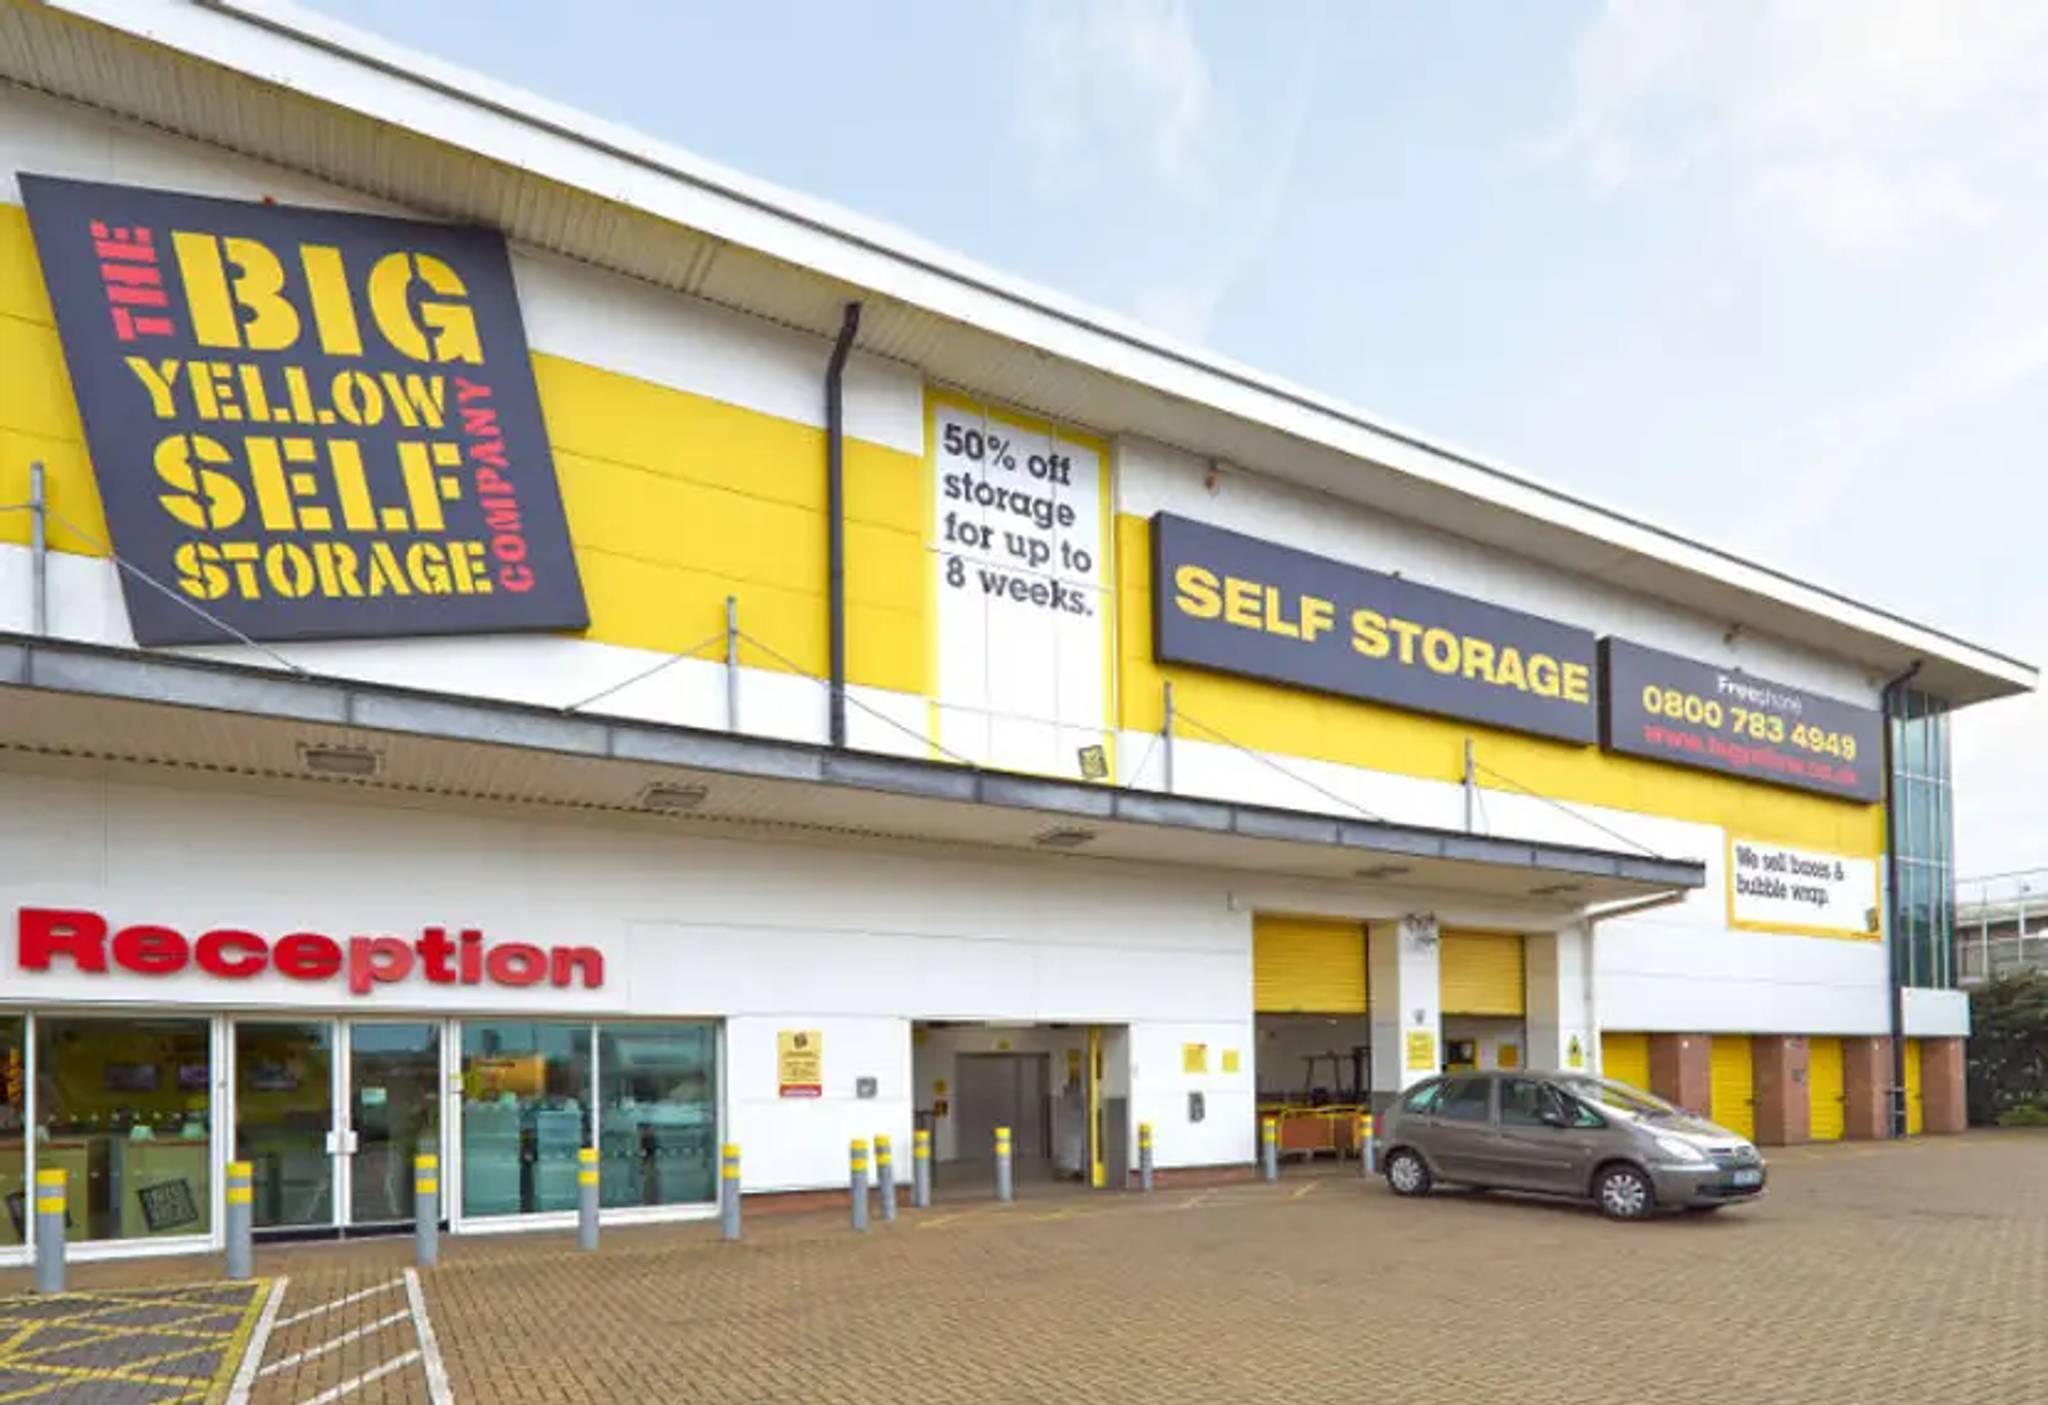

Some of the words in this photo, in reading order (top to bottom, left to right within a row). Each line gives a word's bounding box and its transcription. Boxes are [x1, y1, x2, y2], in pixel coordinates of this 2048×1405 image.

[90, 220, 174, 341] THE
[171, 231, 485, 364] BIG
[124, 357, 444, 429] YELLOW
[153, 434, 462, 531] SELF
[454, 378, 535, 593] COMPANY
[943, 422, 1016, 472] 50%
[1027, 452, 1072, 487] off
[943, 471, 1076, 530] storage
[172, 541, 493, 599] STORAGE
[944, 512, 992, 551] for
[1004, 531, 1050, 568] up
[1061, 540, 1092, 574] to
[945, 556, 966, 590] 8
[979, 568, 1094, 617] weeks.
[1174, 564, 1335, 643] SELF
[1350, 607, 1590, 705] STORAGE
[1642, 684, 1724, 730] 0800
[1730, 706, 1785, 744] 783
[1791, 722, 1857, 762] 4949
[1736, 872, 1787, 899] bubble
[17, 907, 606, 996] Reception
